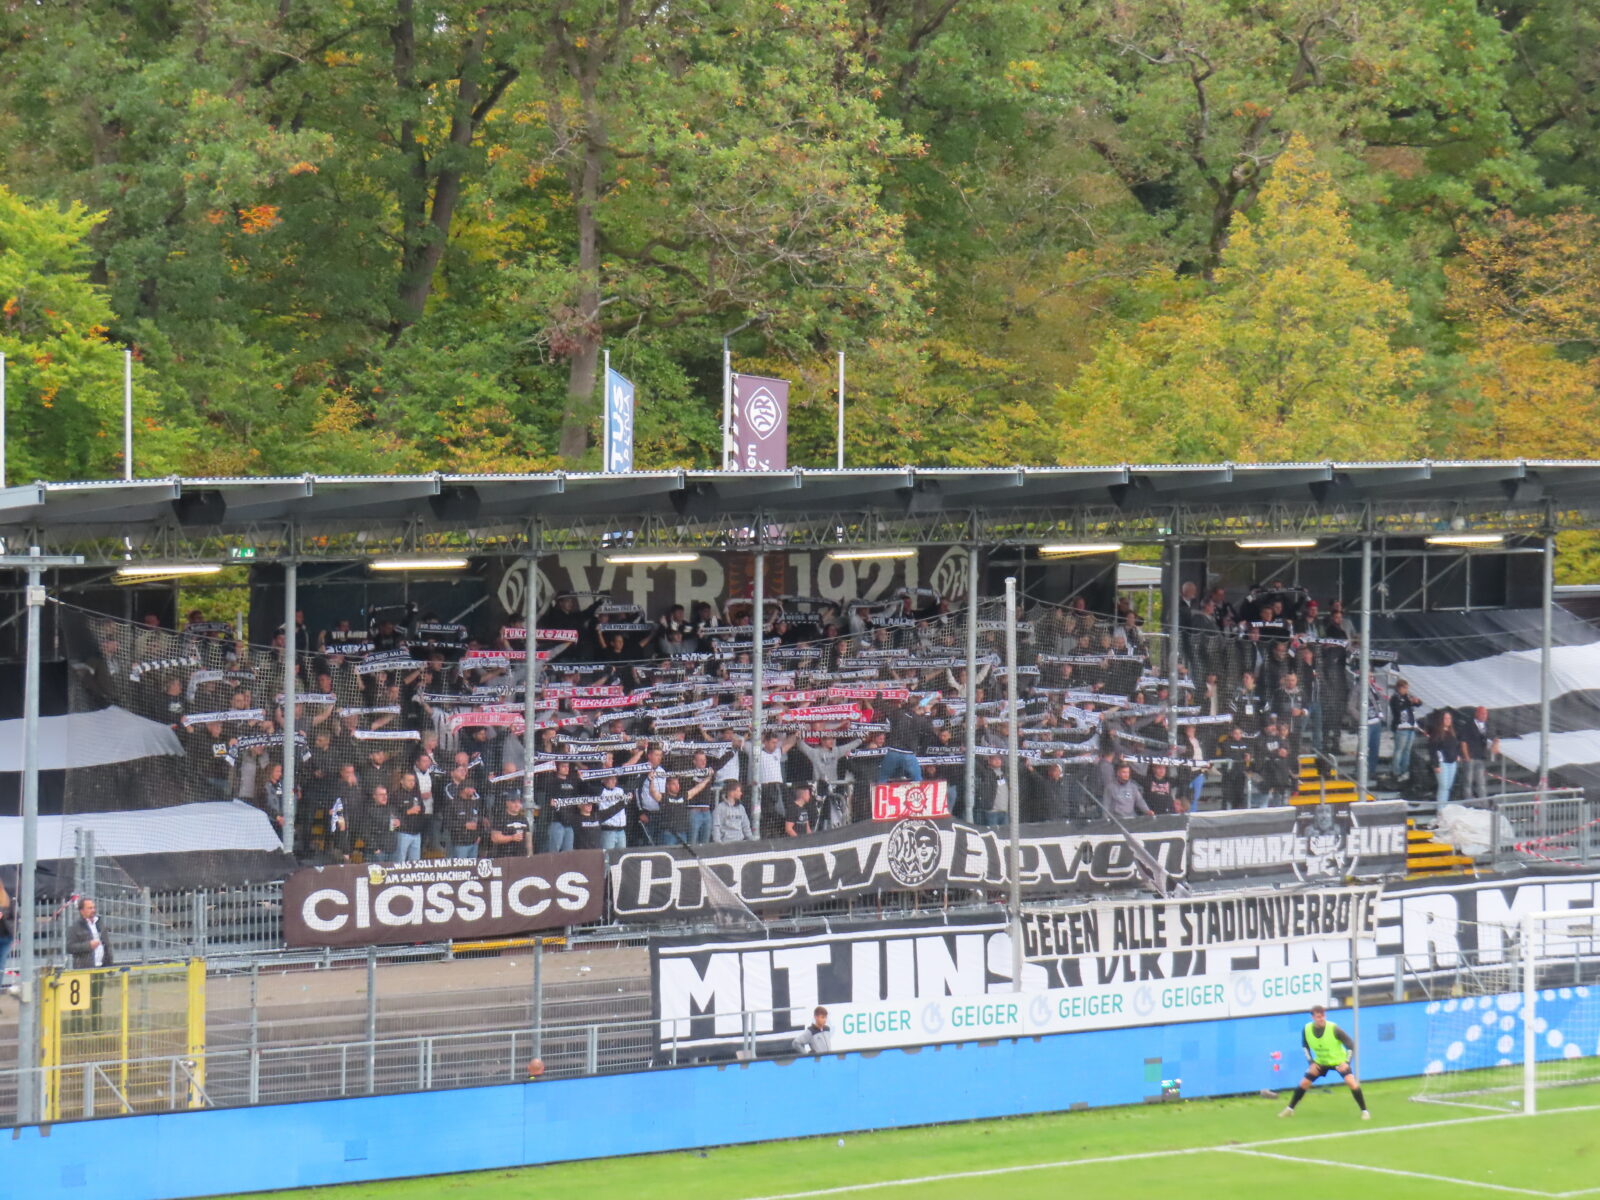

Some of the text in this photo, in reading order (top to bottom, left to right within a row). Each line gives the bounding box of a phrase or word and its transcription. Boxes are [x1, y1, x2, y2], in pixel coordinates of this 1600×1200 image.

[559, 548, 919, 625] VfR 1921
[1347, 825, 1405, 857] ELITE
[401, 871, 436, 883] SAMSTAG
[302, 871, 590, 932] classics
[1021, 909, 1100, 956] GEGEN
[1114, 904, 1167, 951] ALLE
[1180, 890, 1377, 946] STADIONVERBOTE
[70, 979, 80, 1005] 8
[659, 944, 832, 1038] MIT
[1161, 983, 1225, 1009] GEIGER
[1262, 972, 1324, 999] GEIGER
[951, 1004, 1019, 1028] GEIGER
[1058, 993, 1123, 1020] GEIGER
[842, 1010, 912, 1035] GEIGER
